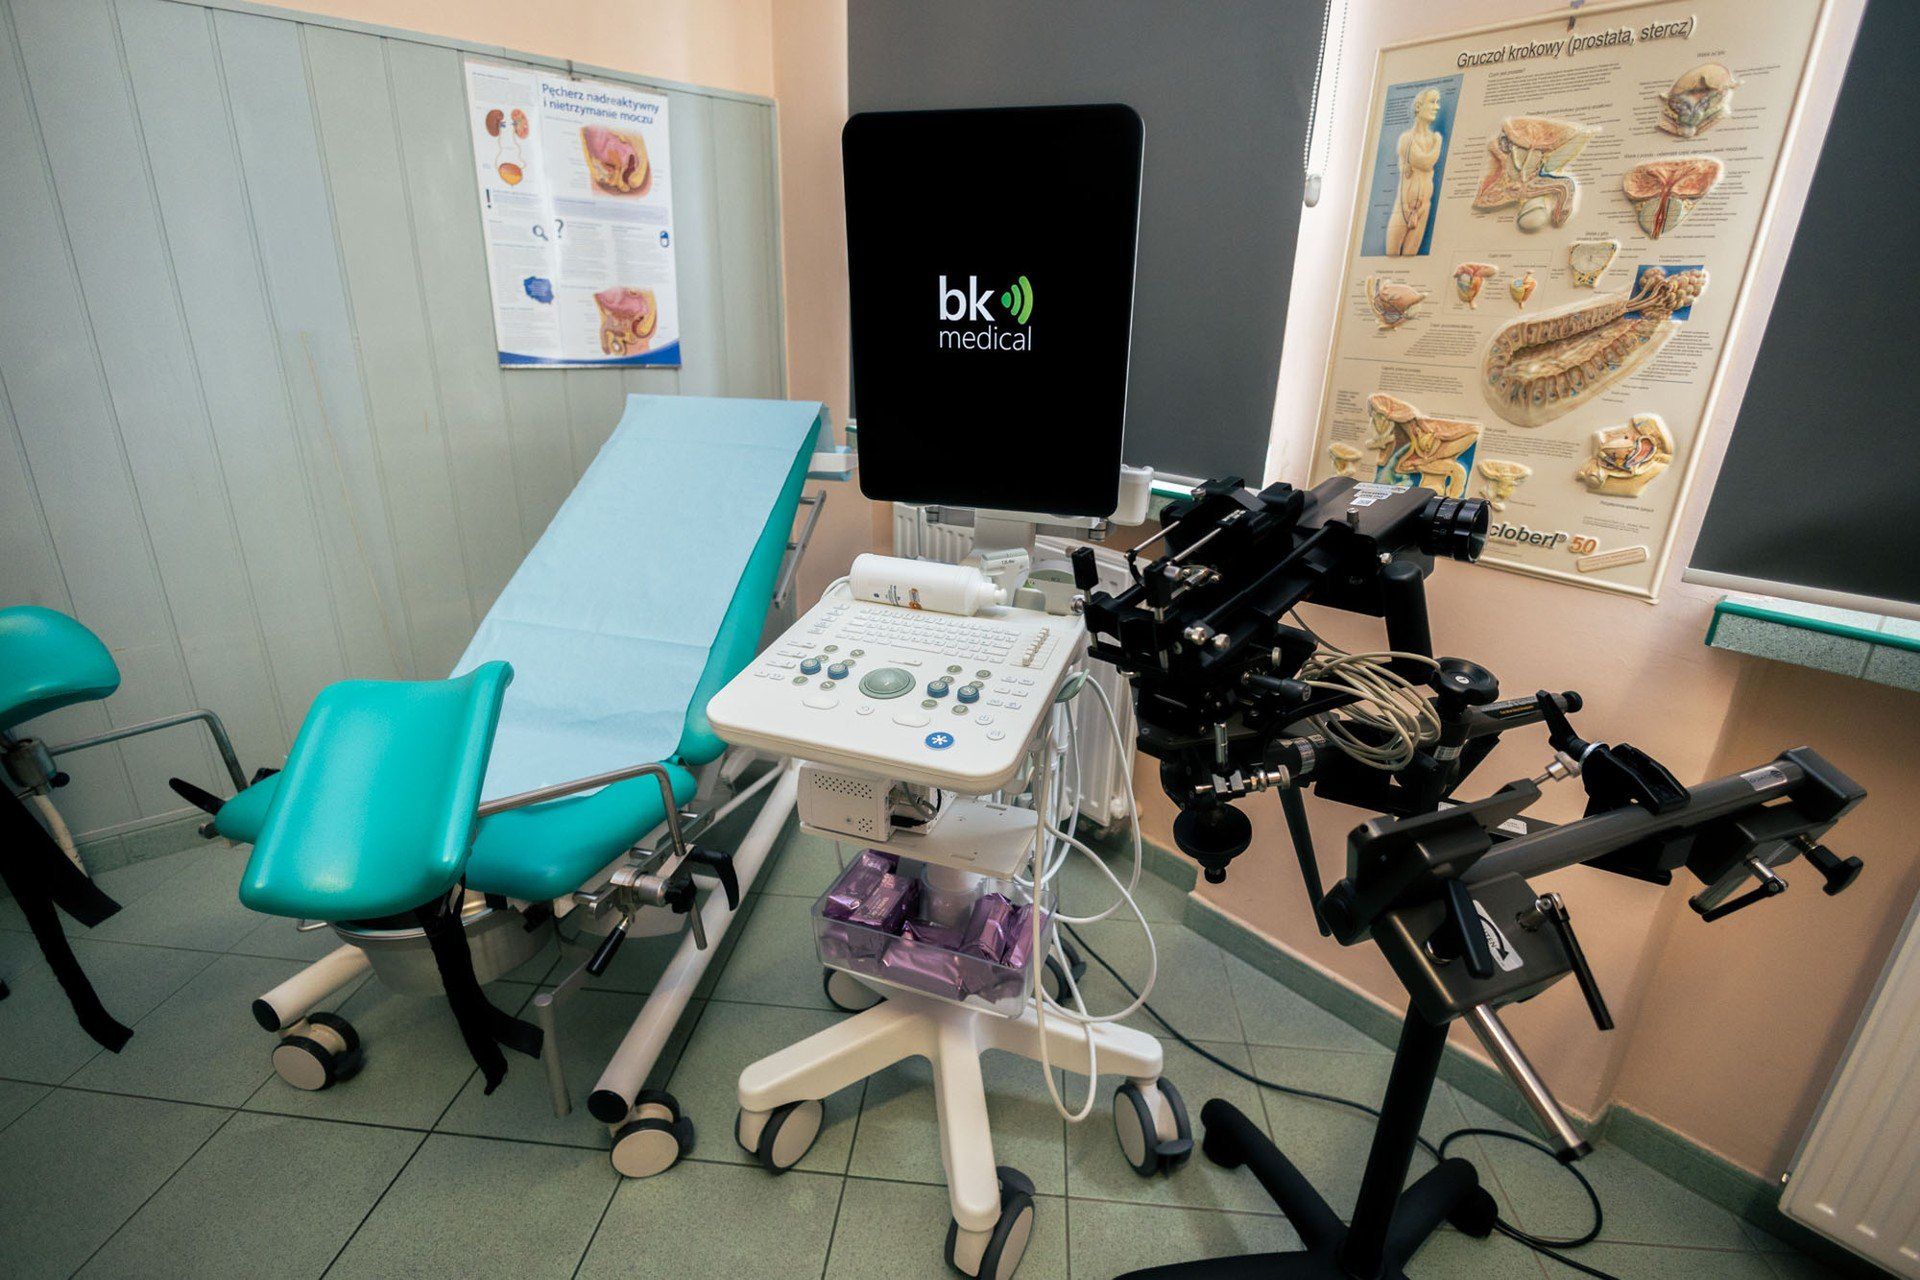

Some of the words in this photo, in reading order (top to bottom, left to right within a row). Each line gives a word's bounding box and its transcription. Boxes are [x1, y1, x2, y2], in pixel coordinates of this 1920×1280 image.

[1457, 49, 1506, 68] Gruczoł
[1508, 40, 1565, 61] krokowy
[1567, 27, 1635, 56] (prostata,
[1640, 16, 1696, 41] stercz)
[542, 83, 584, 100] Pęcherz
[586, 93, 660, 114] nadreaktywny
[549, 101, 618, 119] nietrzymanie
[620, 112, 653, 124] moczu
[939, 275, 995, 321] bk
[939, 325, 1032, 351] medical
[1570, 536, 1598, 555] 50
